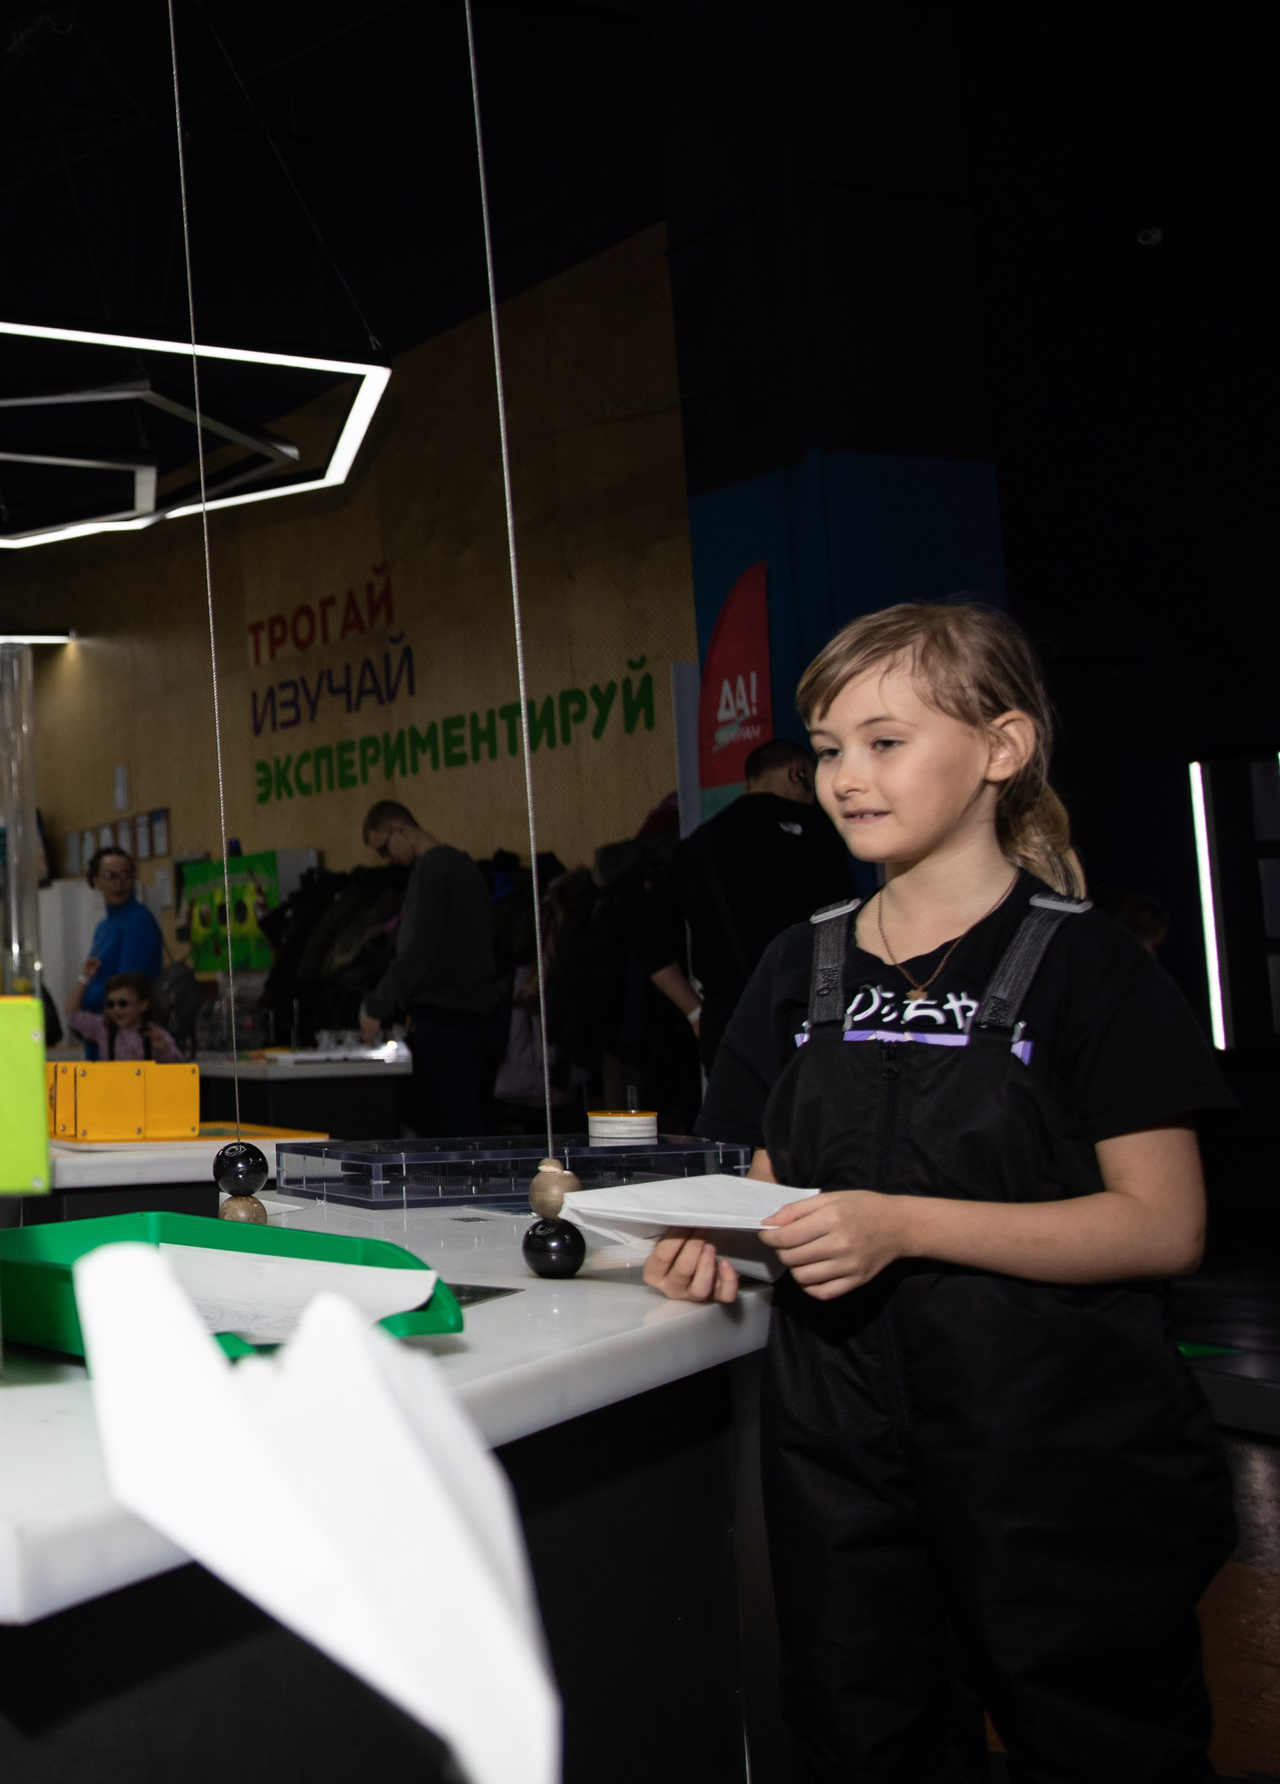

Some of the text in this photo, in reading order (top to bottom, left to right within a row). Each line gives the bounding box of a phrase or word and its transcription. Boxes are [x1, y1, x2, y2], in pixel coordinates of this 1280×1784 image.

[247, 563, 395, 668] ТРОГАЙ
[250, 630, 417, 737] ИЗУЧАЙ
[254, 654, 657, 805] ЭКСПЕРИМЕНТИРУЙ
[716, 671, 758, 722] ДА!
